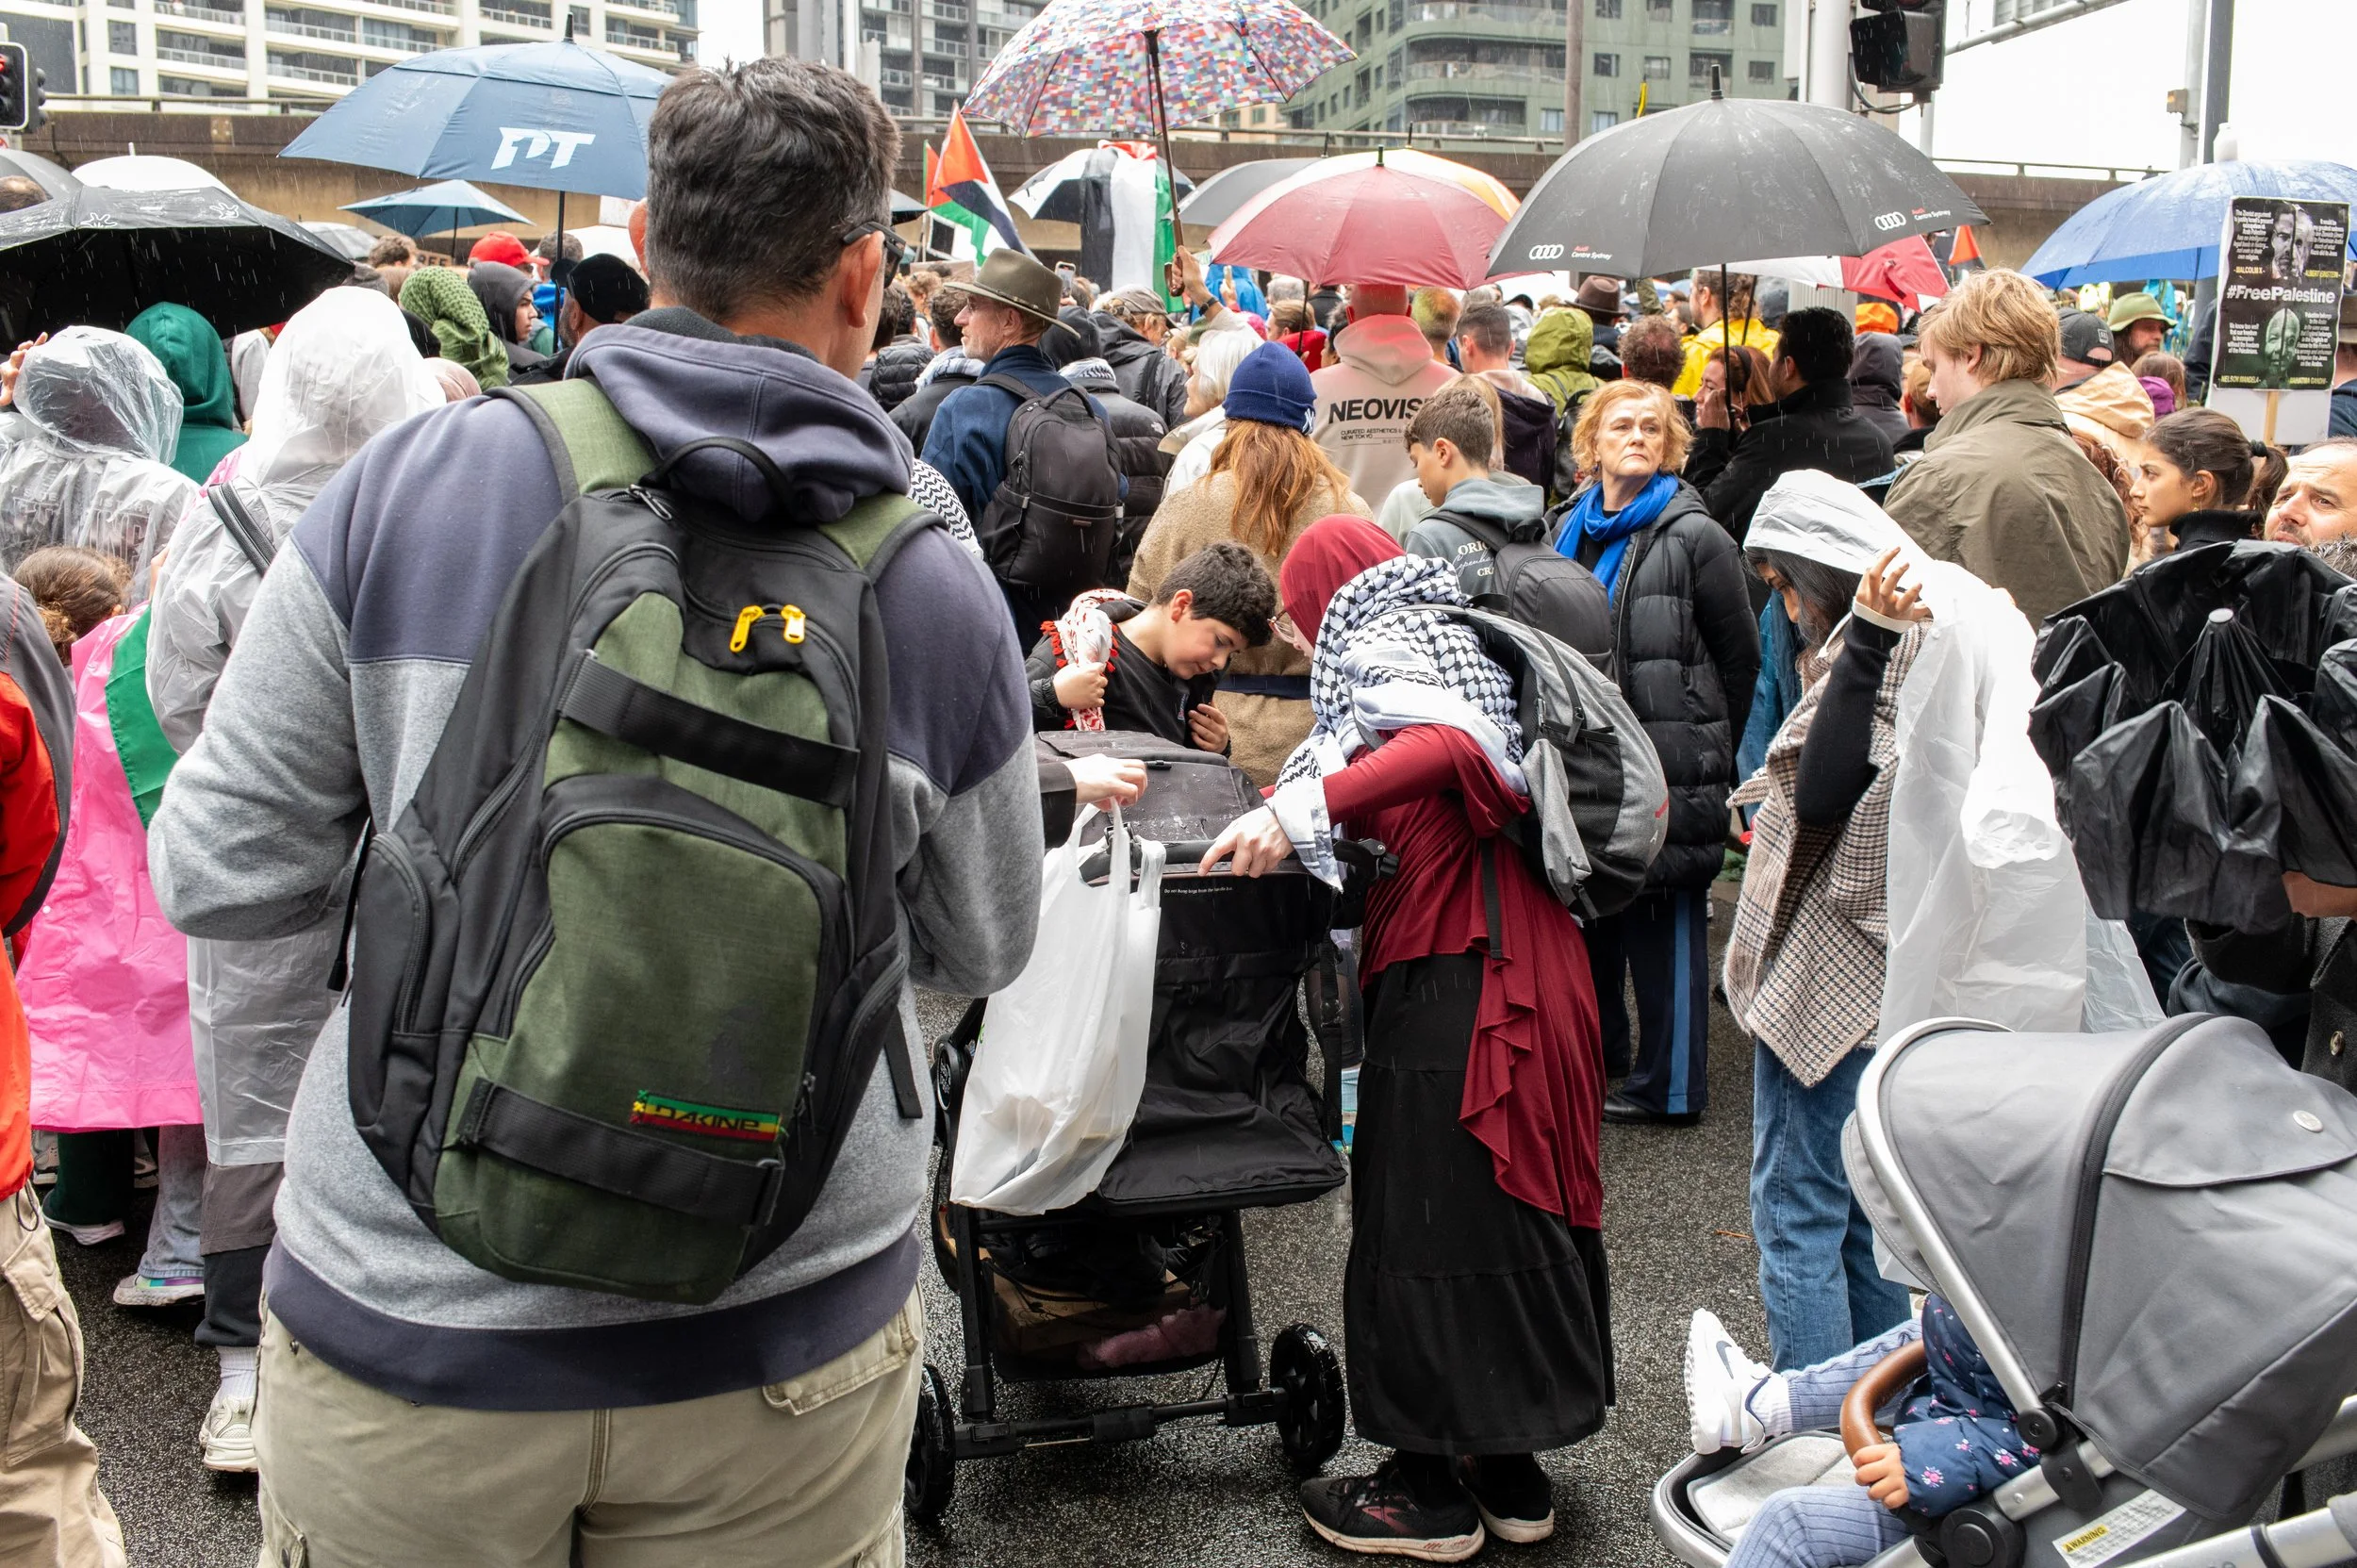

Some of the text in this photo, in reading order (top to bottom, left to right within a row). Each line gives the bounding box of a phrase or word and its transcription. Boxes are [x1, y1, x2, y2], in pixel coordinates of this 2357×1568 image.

[490, 127, 596, 170] PT
[2227, 285, 2335, 303] #FreePalestine
[1328, 398, 1426, 423] NEOVIS
[655, 1104, 759, 1132] DAKINE
[2070, 1527, 2106, 1549] WARNING
